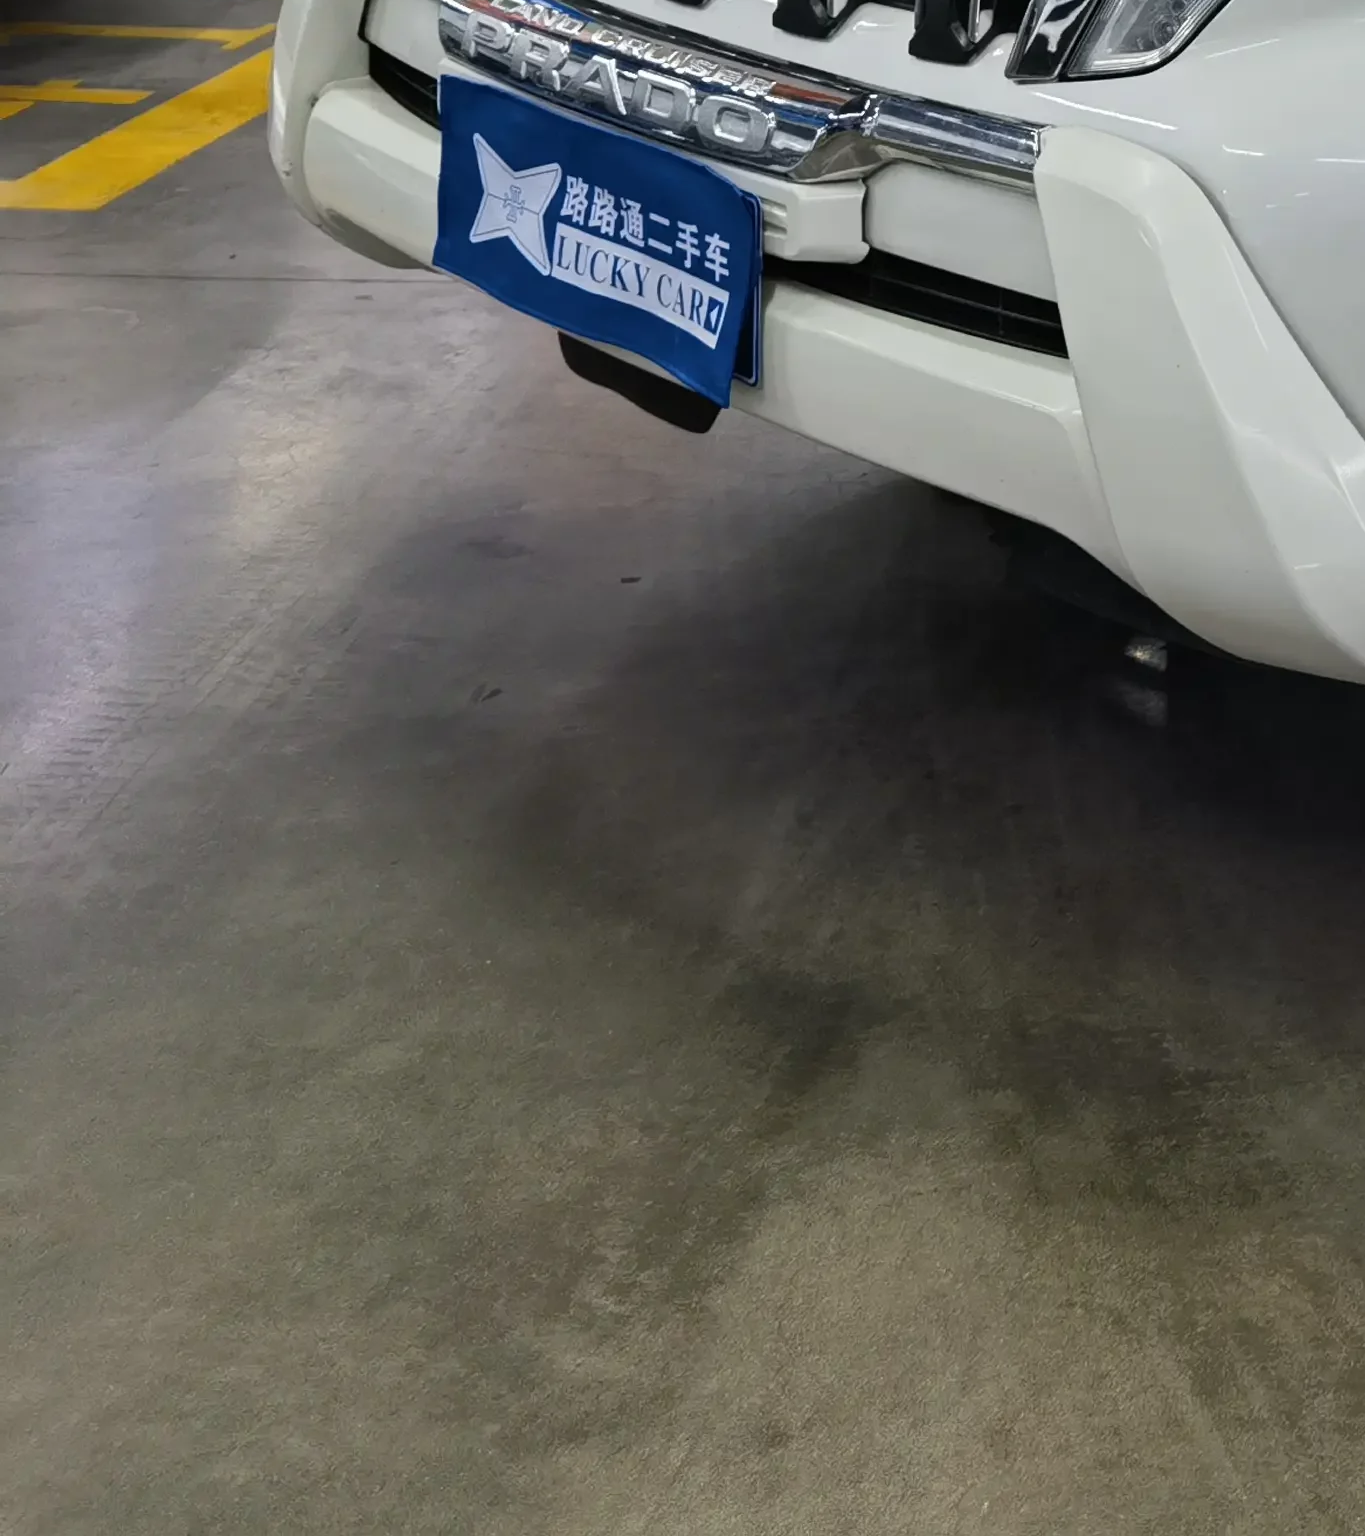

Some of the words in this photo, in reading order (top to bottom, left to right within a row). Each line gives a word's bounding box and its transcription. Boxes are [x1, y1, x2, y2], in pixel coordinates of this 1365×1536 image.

[461, 11, 777, 153] PRADO
[590, 27, 777, 97] CRUISER
[561, 175, 730, 282] 路路通二手车
[556, 234, 651, 299] LUCKY
[656, 273, 704, 327] CAR
